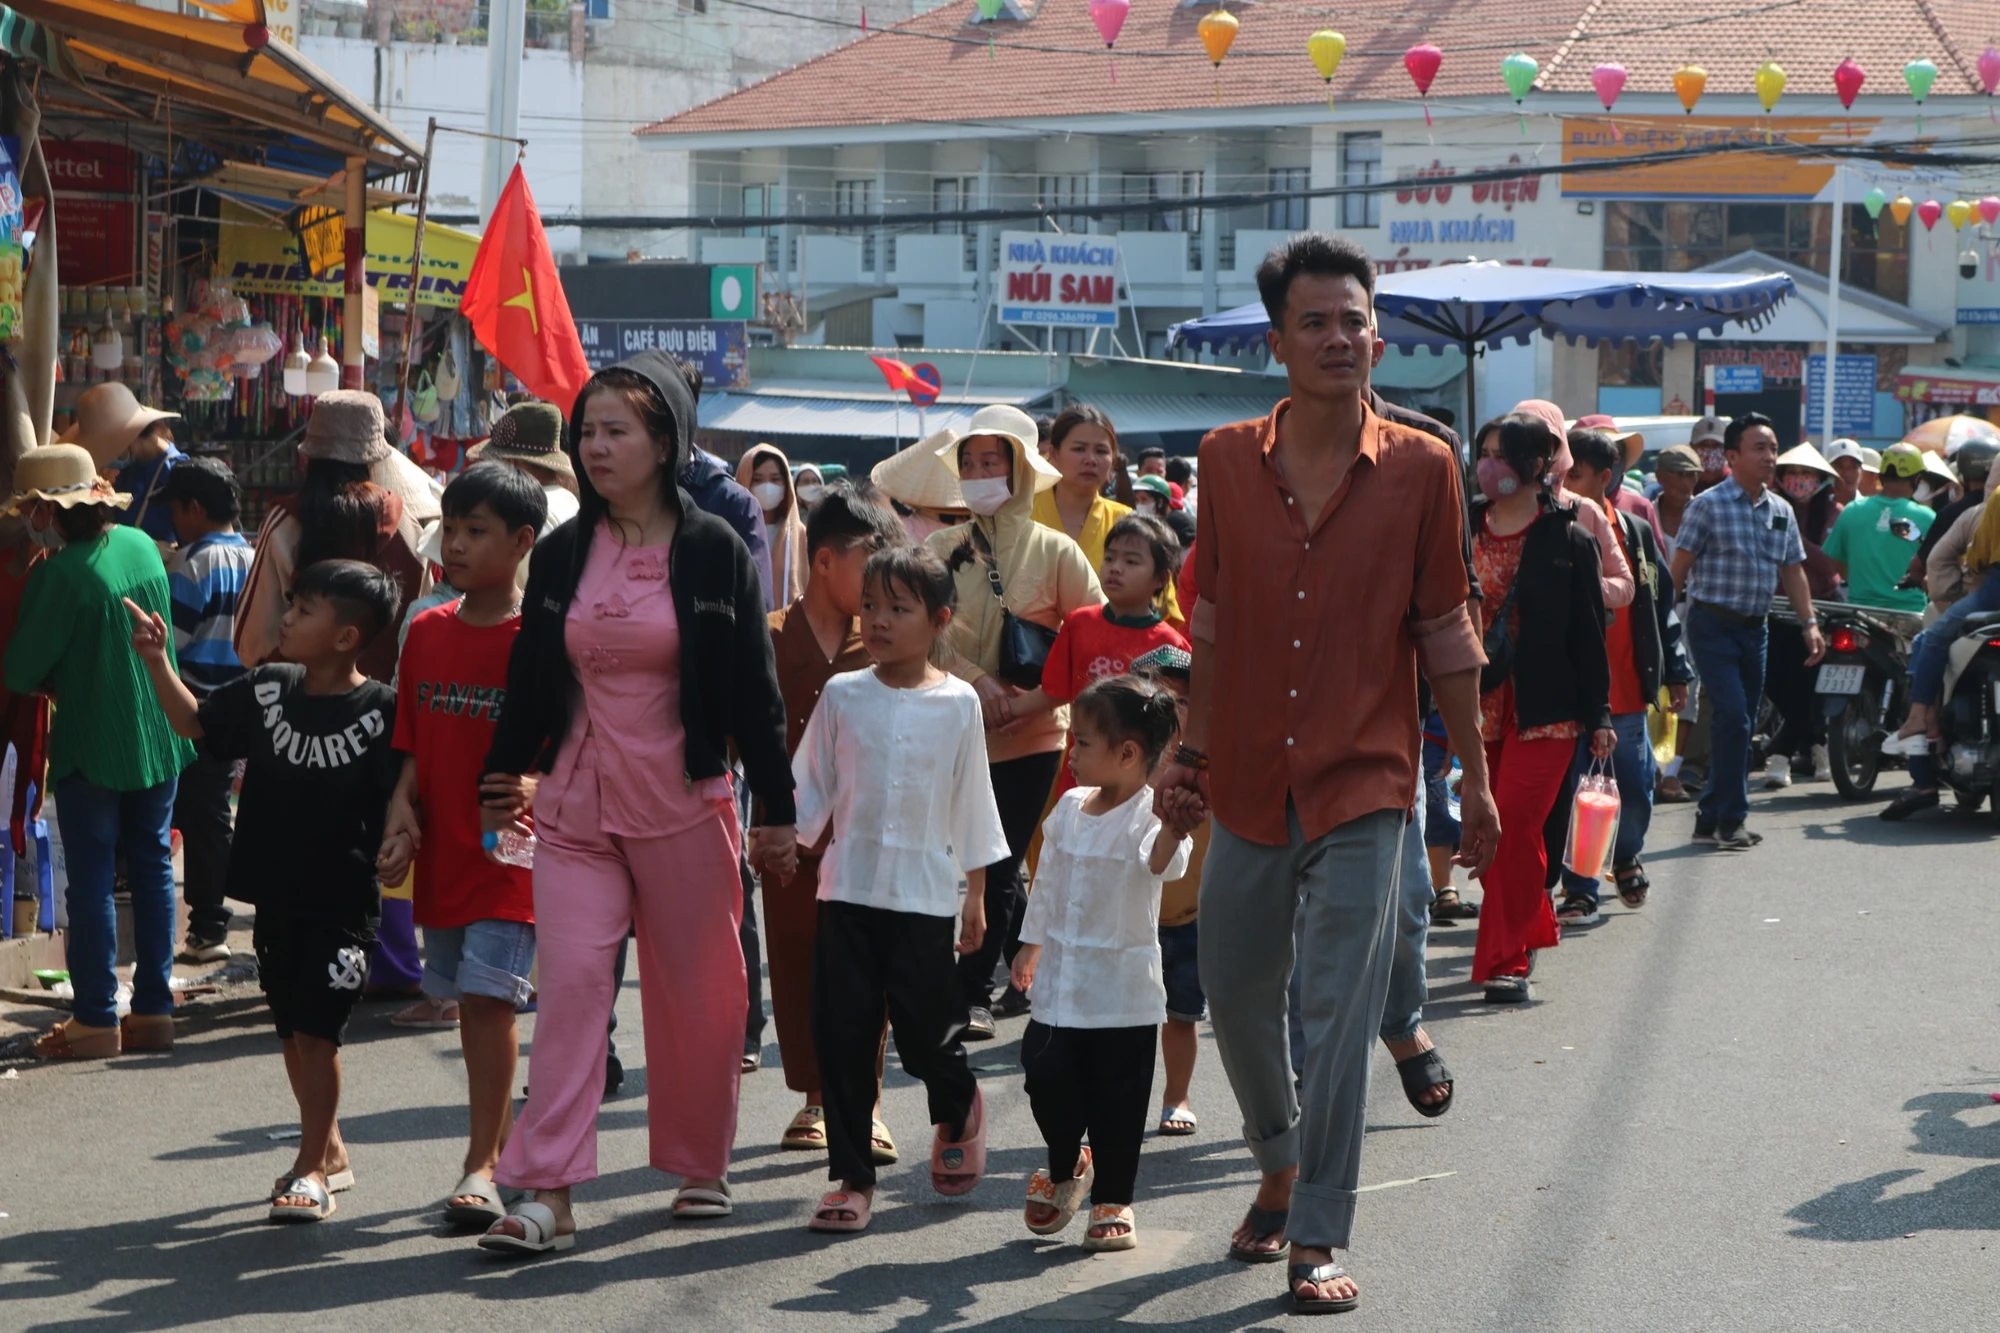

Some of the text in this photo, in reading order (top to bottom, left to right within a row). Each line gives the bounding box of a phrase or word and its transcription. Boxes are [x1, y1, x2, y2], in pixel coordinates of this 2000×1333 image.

[1438, 213, 1514, 243] KHÁCH
[1008, 239, 1114, 266] NHÀ KHÁCH
[1008, 264, 1114, 304] NÚI SAM
[624, 325, 717, 357] CAFÉ BƯU ĐIỆN
[1822, 679, 1854, 692] 7317
[254, 681, 385, 768] DSQUARED
